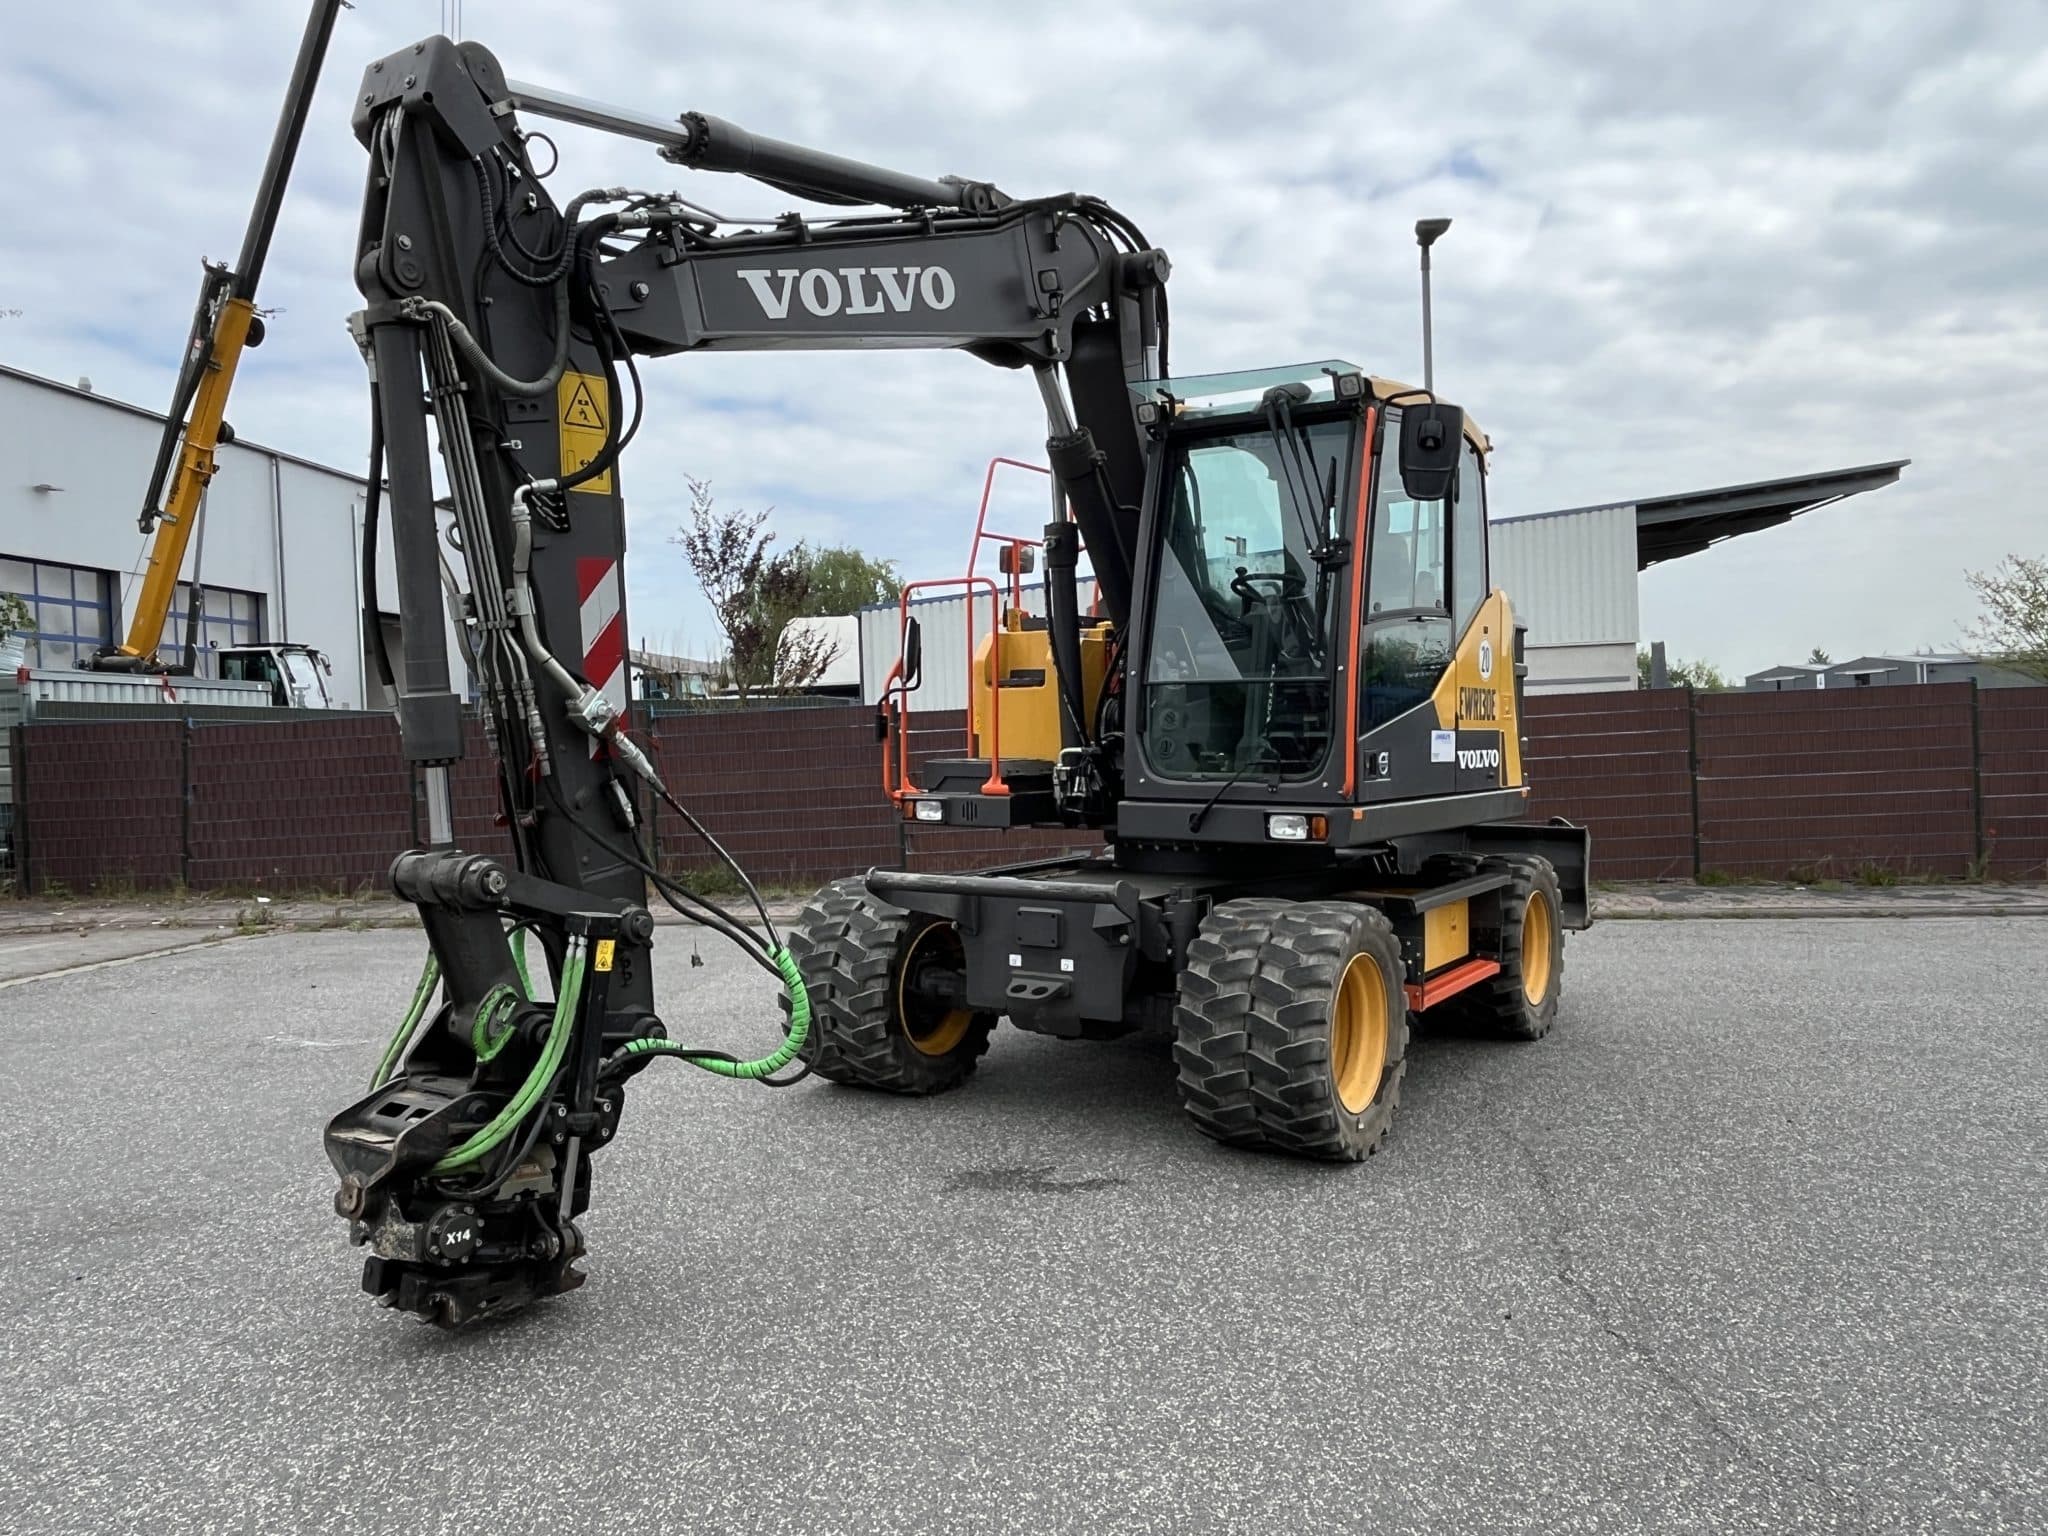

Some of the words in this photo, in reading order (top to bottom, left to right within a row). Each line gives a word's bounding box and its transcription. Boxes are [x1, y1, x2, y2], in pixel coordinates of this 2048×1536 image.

[737, 265, 956, 320] VOLVO
[1481, 645, 1490, 673] 20
[1459, 686, 1497, 721] EWR130E
[1457, 749, 1499, 769] VOLVO
[446, 1228, 471, 1245] X14
